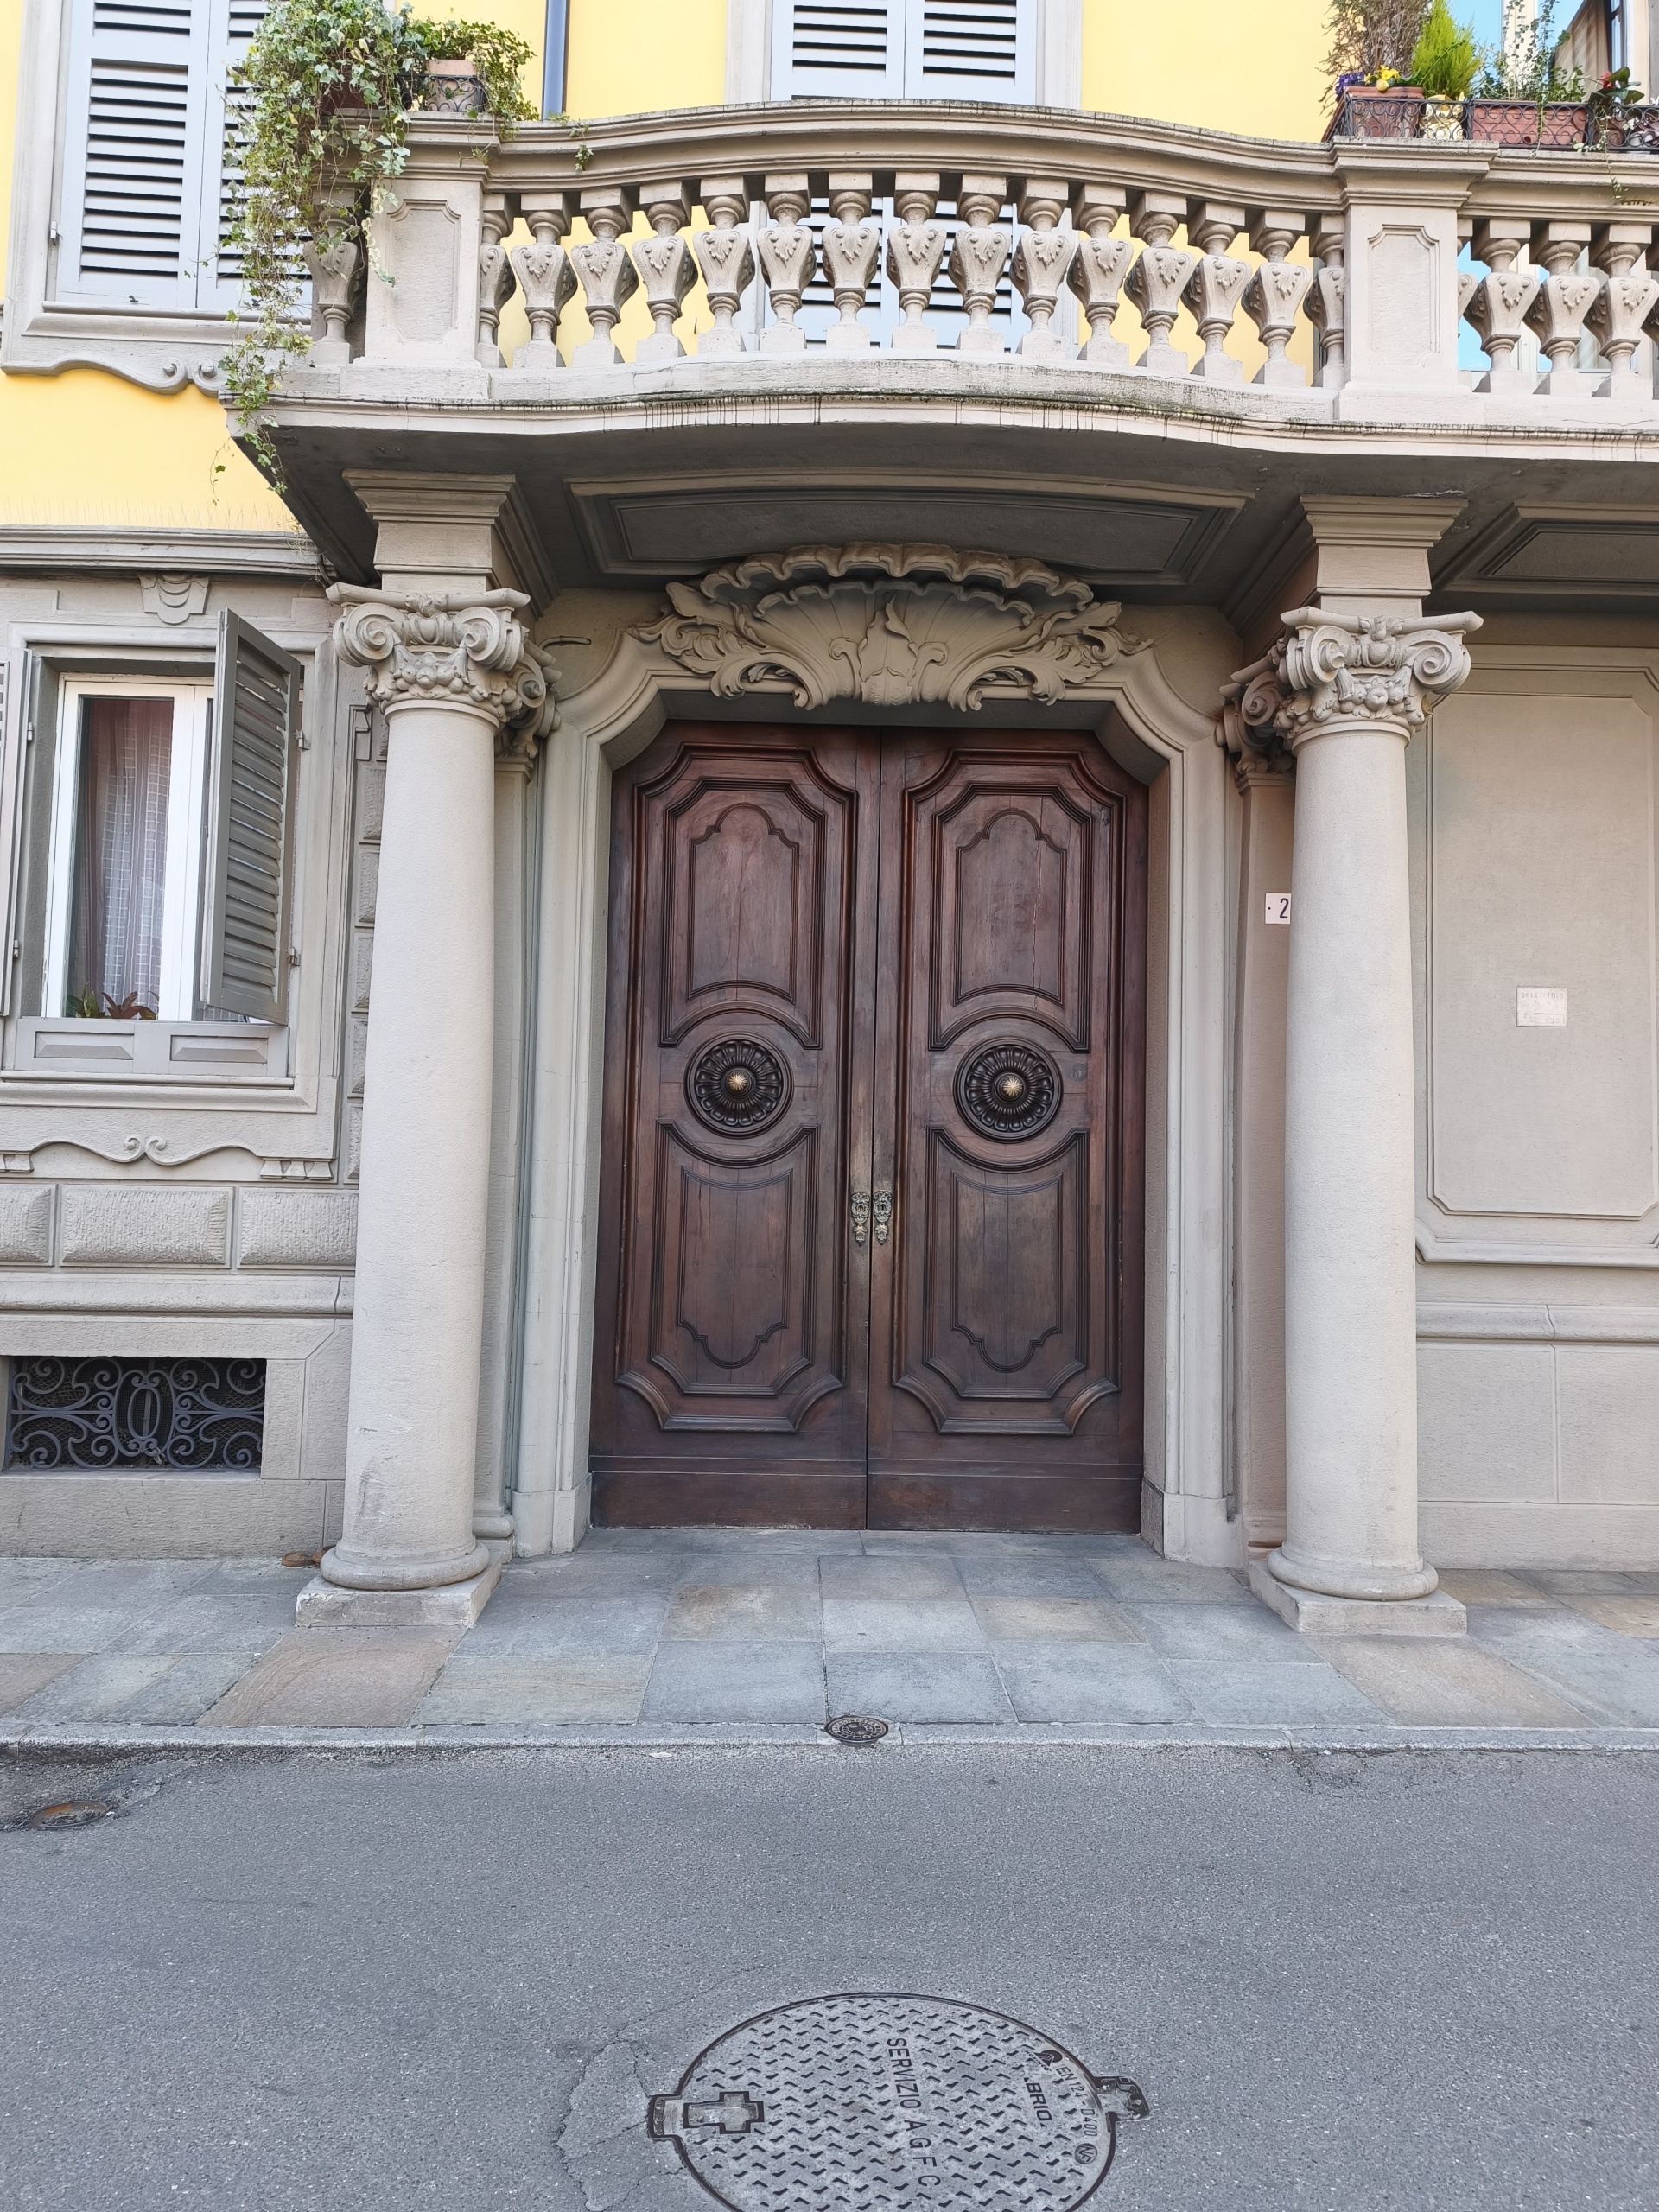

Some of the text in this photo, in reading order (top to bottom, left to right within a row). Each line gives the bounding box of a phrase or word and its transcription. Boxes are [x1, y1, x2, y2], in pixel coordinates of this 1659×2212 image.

[1280, 898, 1289, 919] 2
[887, 2037, 922, 2109] SERVIZIO
[1026, 2082, 1052, 2121] BRIO
